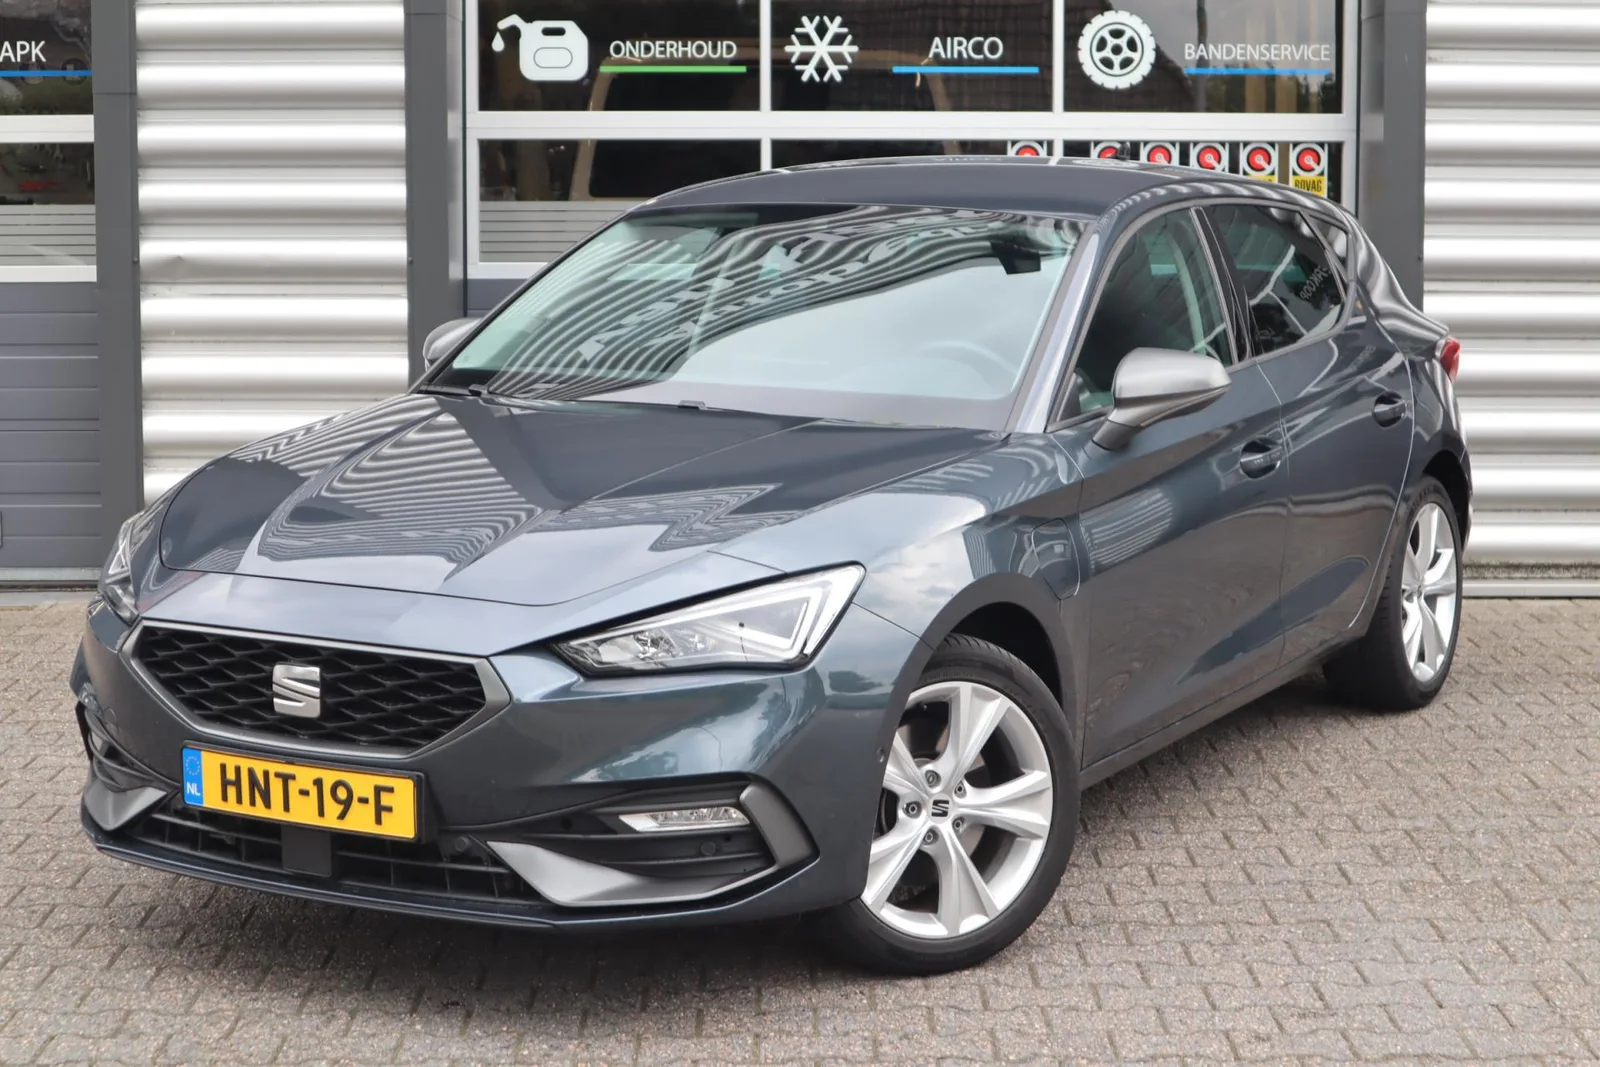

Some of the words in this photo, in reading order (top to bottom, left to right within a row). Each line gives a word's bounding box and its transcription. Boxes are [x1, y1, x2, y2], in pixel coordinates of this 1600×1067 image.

[0, 40, 46, 62] APK
[609, 39, 737, 58] ONDERHOUD
[928, 36, 1004, 59] AIRCO
[1184, 43, 1331, 61] BANDENSERVICE
[187, 782, 201, 796] NL
[219, 763, 395, 825] HNT-19-F
